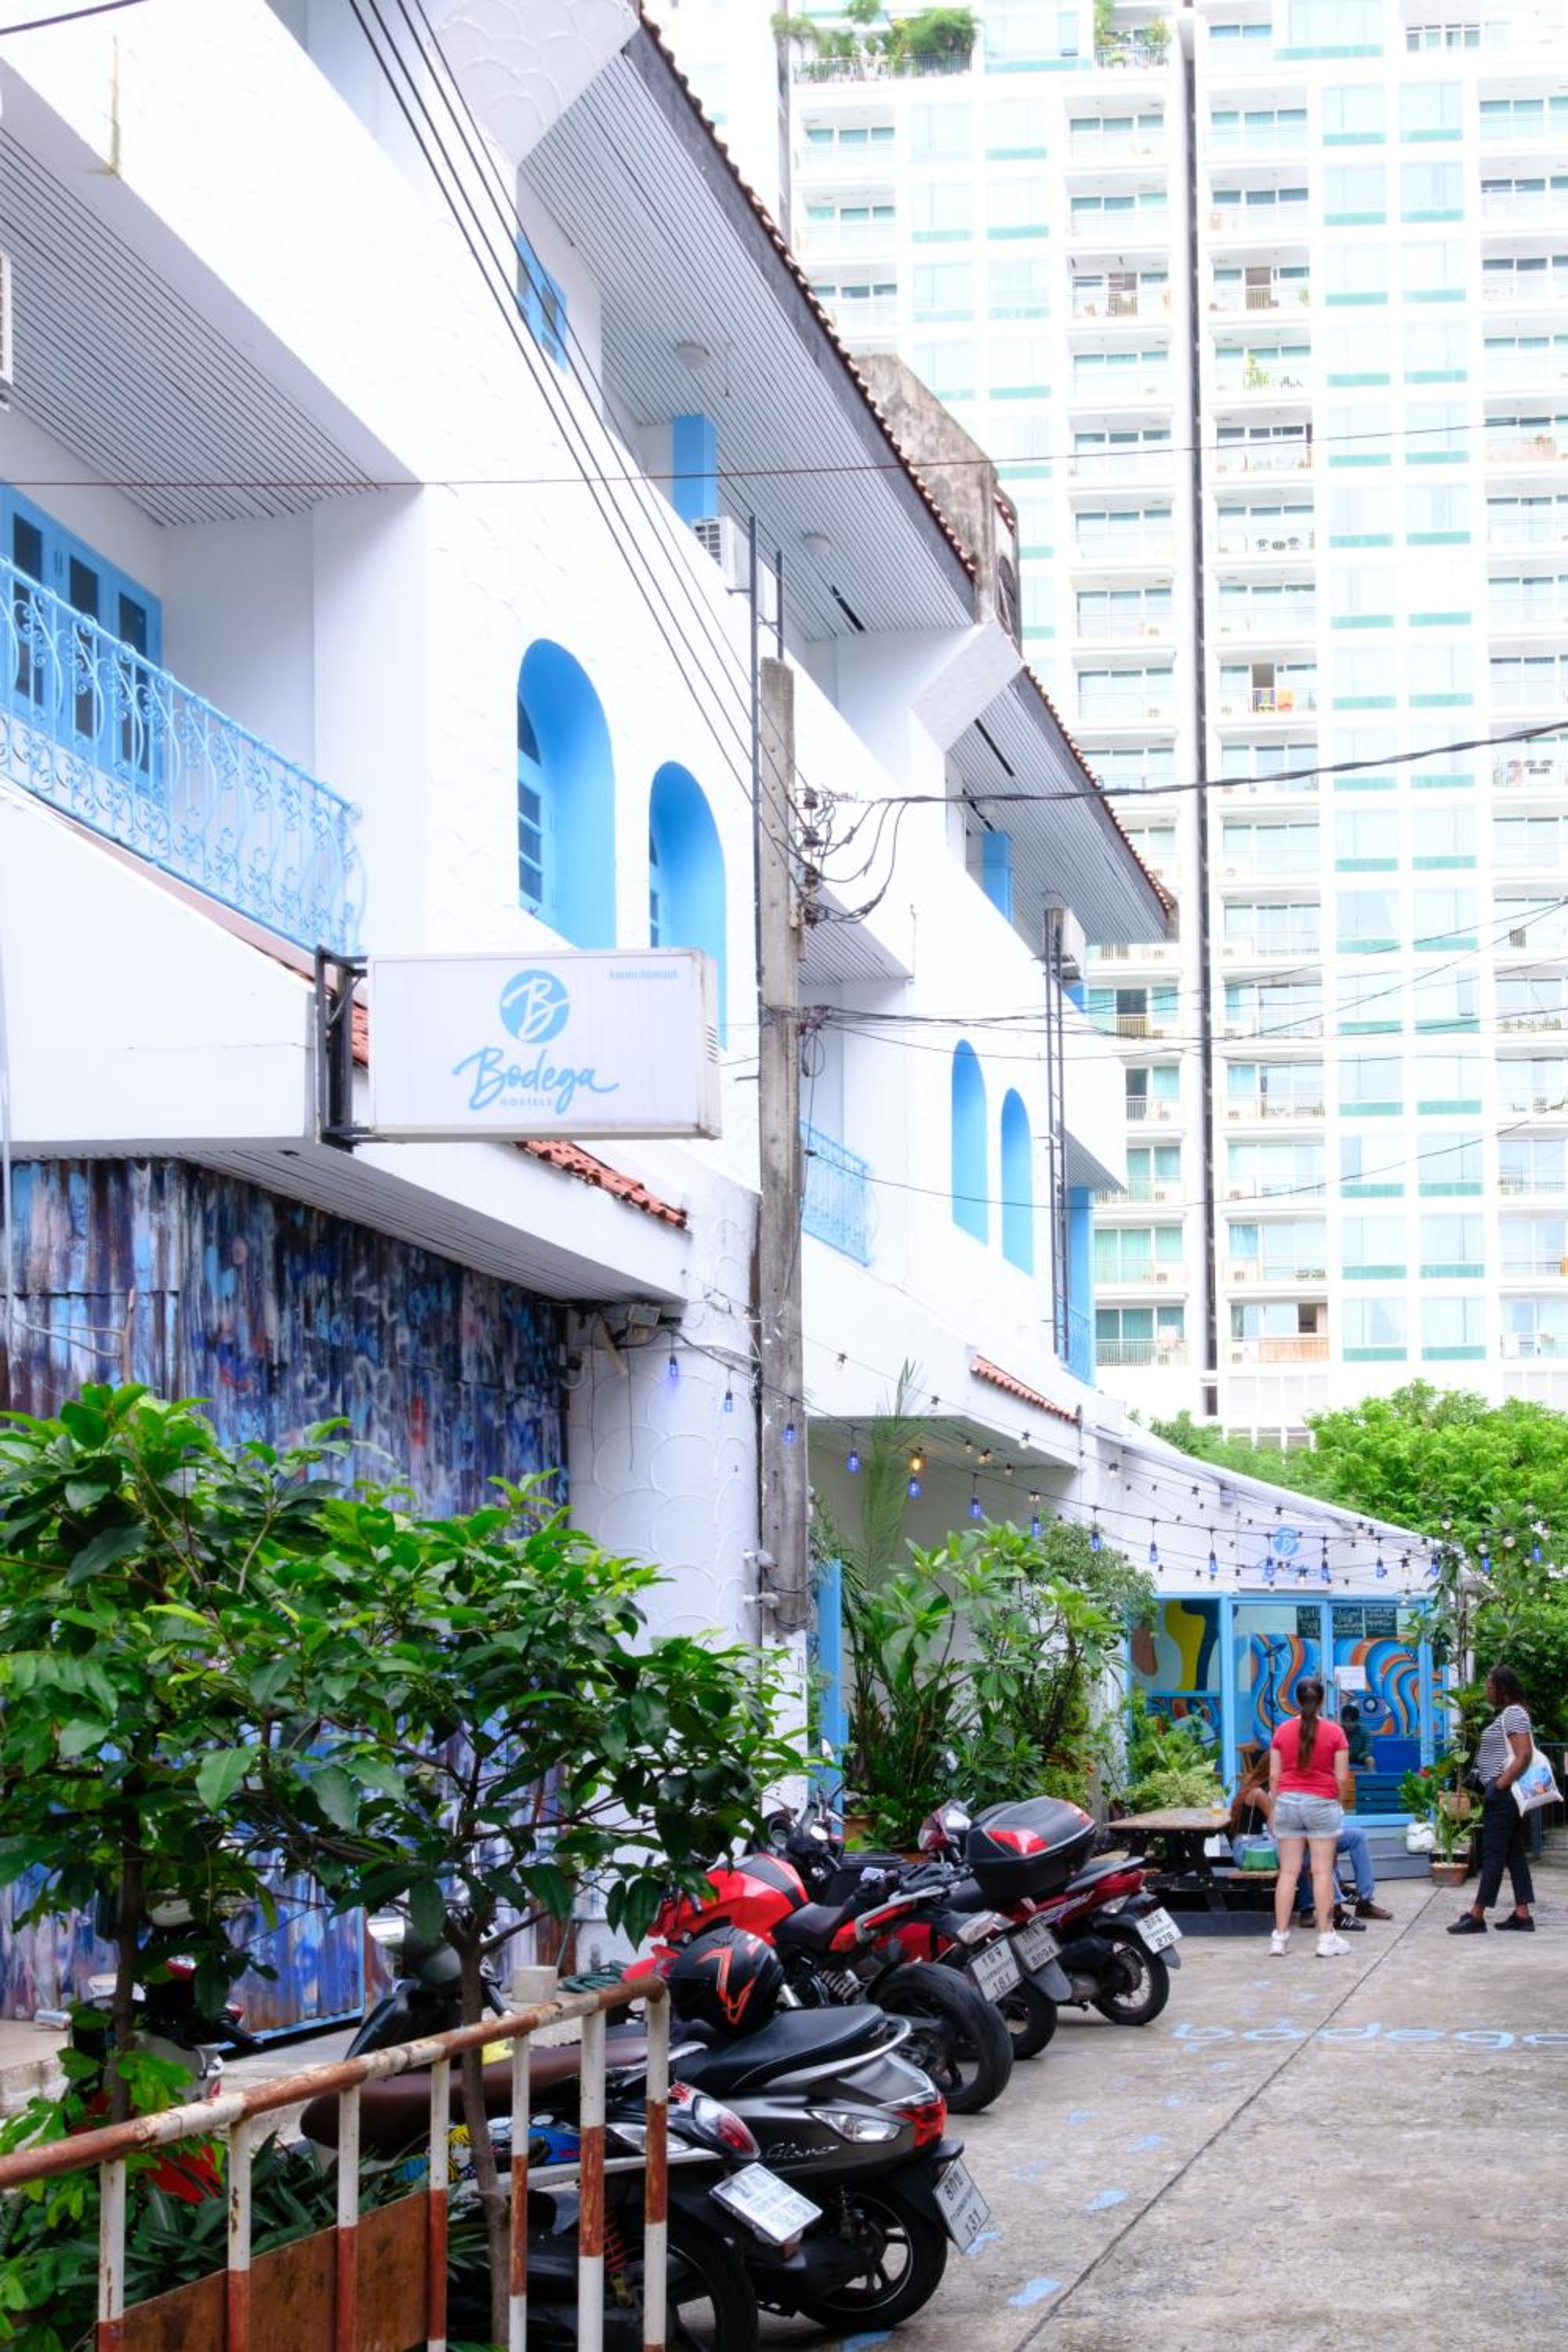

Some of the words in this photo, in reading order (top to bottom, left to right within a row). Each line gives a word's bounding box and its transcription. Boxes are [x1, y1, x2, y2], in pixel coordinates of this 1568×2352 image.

[501, 978, 570, 1040] B
[452, 1047, 619, 1114] Bodega
[499, 1097, 553, 1106] HOSTELS
[1155, 1931, 1175, 1947] 278
[993, 1969, 1011, 1995] 181
[964, 2207, 982, 2238] 131
